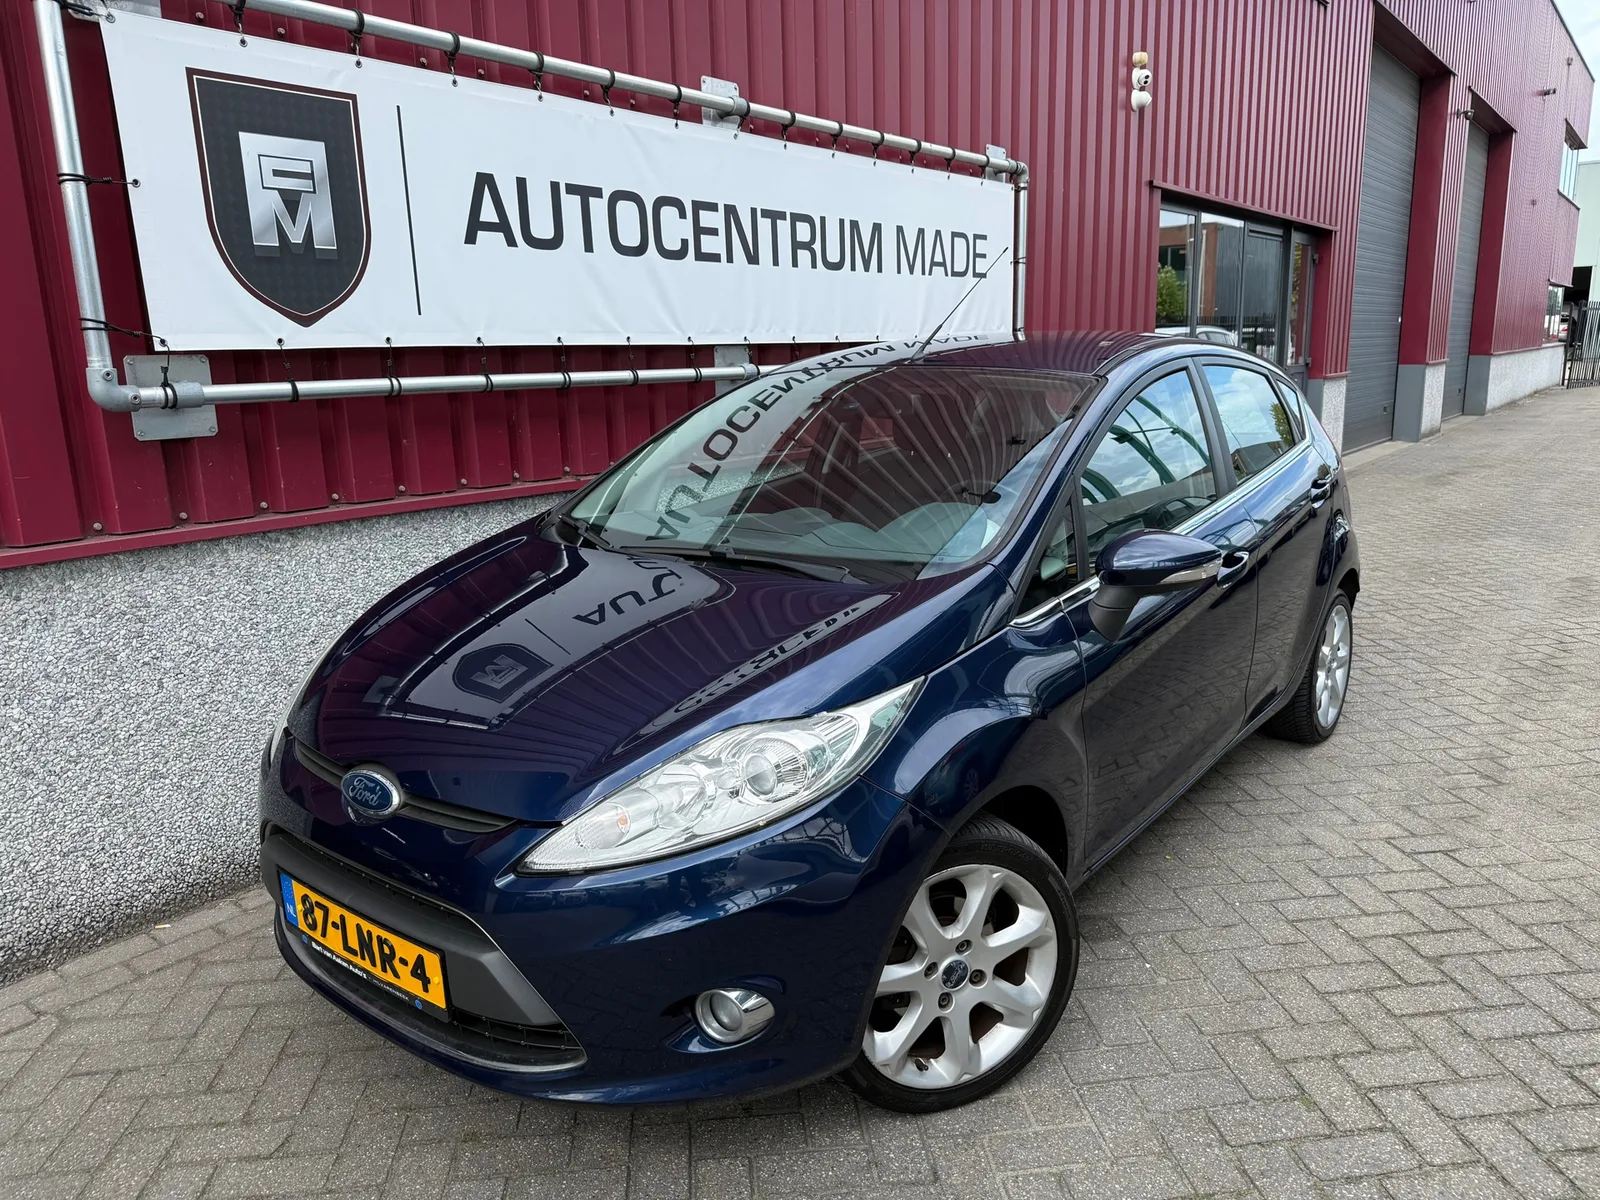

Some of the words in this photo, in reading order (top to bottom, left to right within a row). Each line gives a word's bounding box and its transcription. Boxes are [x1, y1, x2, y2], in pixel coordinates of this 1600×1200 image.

[464, 171, 883, 274] AUTOCENTRUM
[896, 224, 988, 279] MADE
[348, 776, 382, 807] Ford
[285, 902, 298, 918] NL
[301, 893, 431, 994] 87-LNR-4
